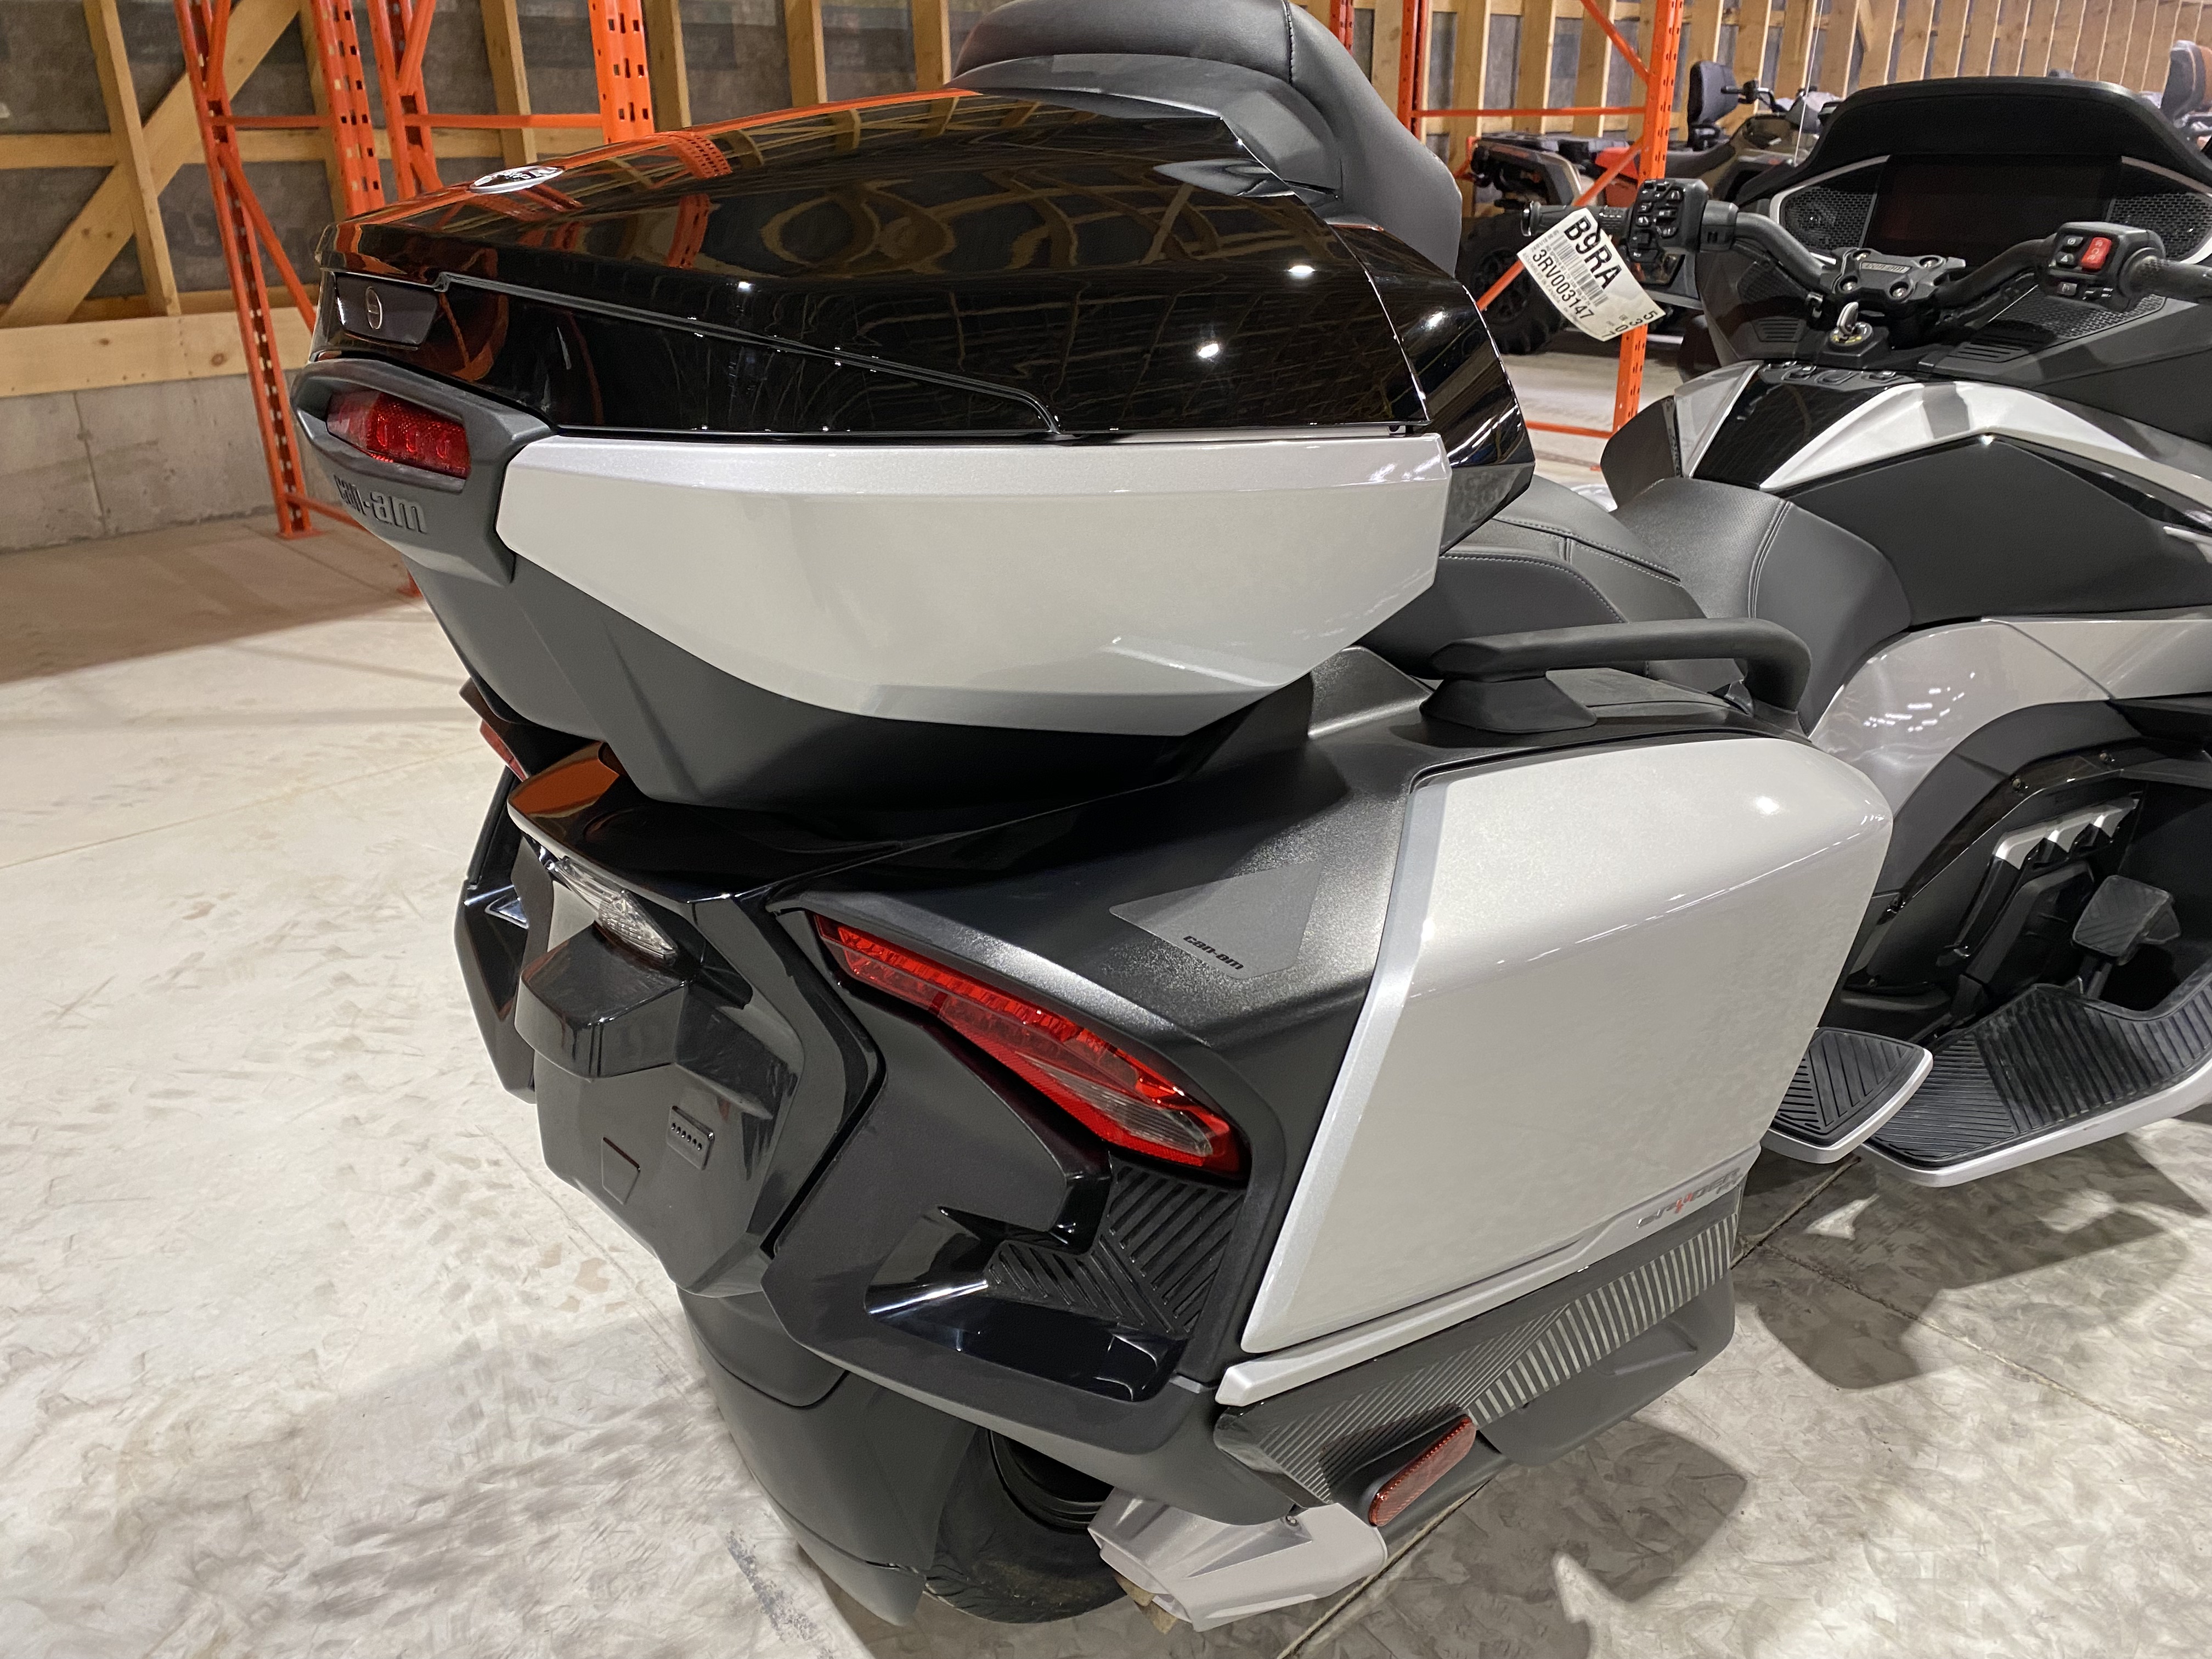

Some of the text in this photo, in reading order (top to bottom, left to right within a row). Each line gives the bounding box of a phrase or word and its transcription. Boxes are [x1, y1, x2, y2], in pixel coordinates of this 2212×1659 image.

[1532, 249, 1594, 319] 3RV003147
[1564, 215, 1622, 290] B9RA
[333, 475, 427, 534] can-am
[1183, 935, 1245, 970] can-am
